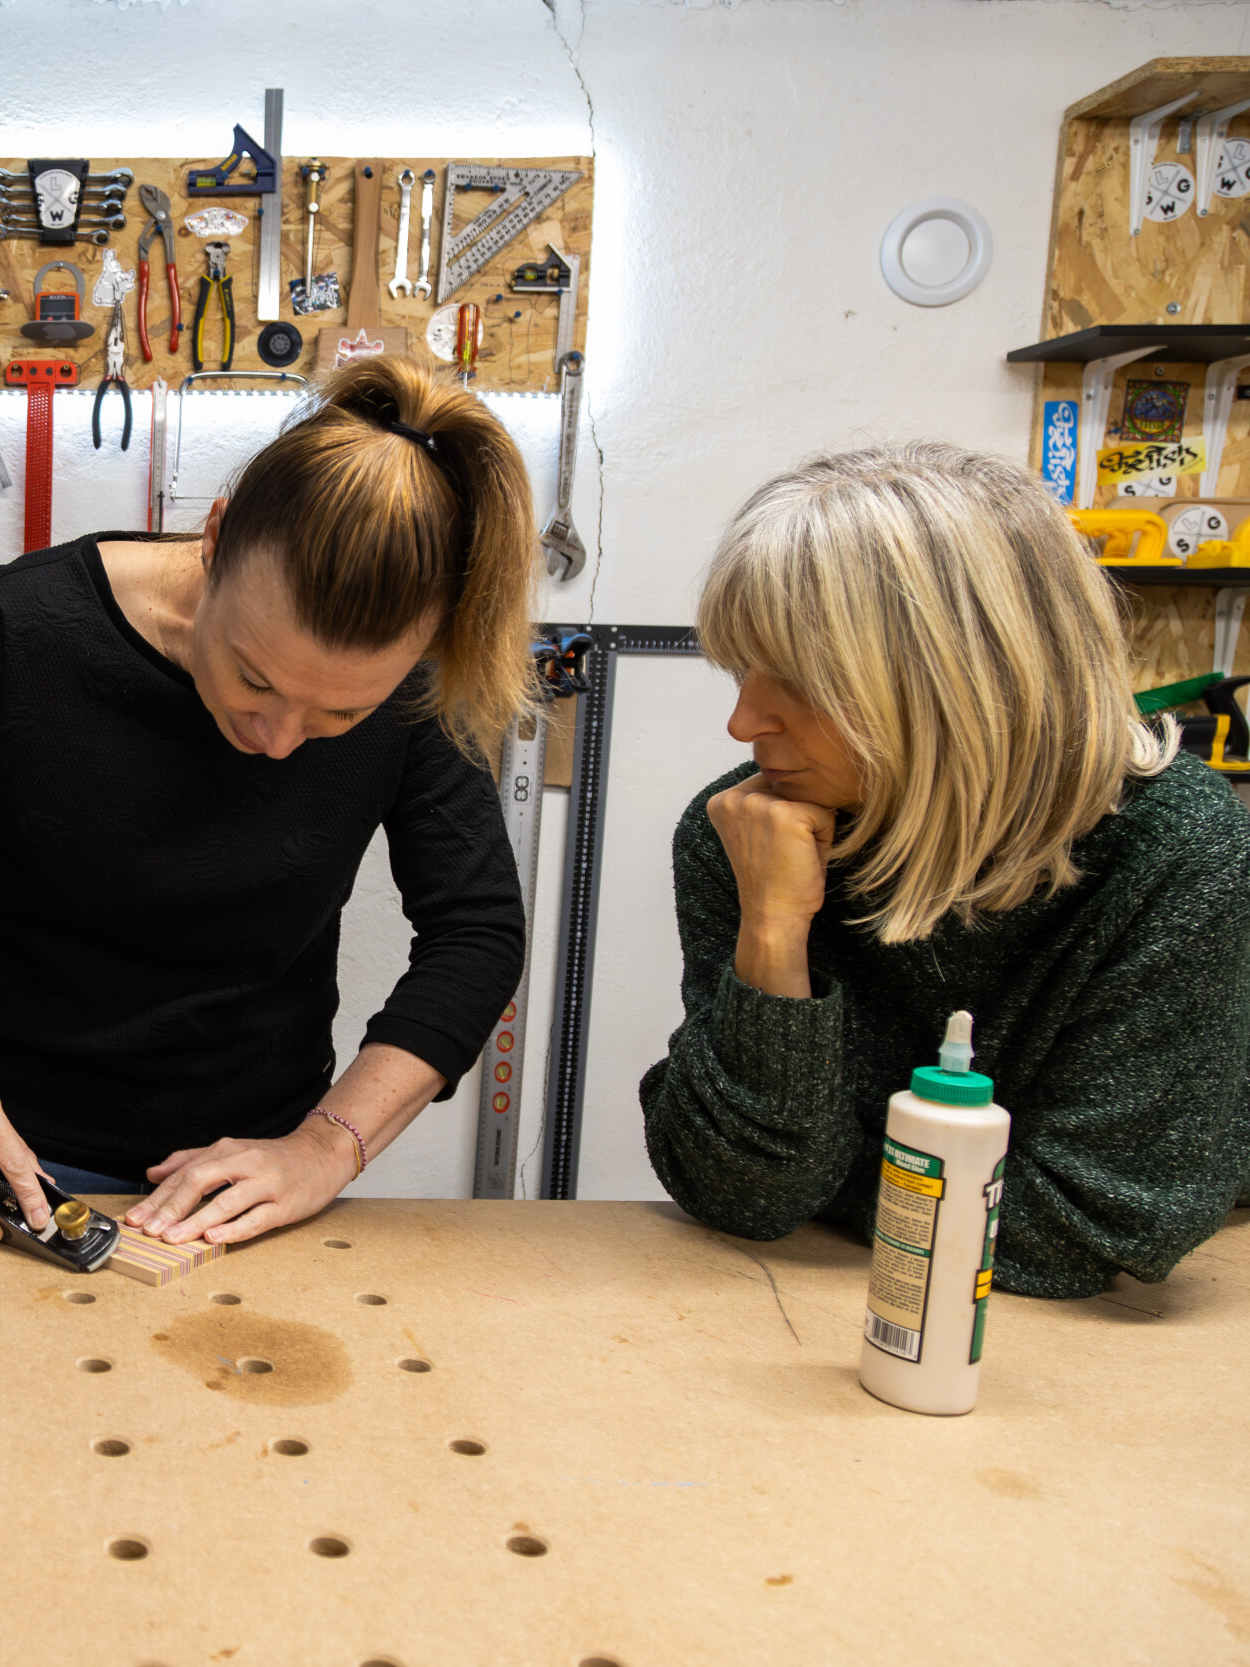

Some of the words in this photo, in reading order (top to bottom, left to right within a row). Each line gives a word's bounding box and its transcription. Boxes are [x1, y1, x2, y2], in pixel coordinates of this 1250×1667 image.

[1177, 178, 1190, 193] G
[1160, 201, 1175, 215] W
[50, 209, 64, 222] W
[1207, 516, 1221, 530] G
[1177, 538, 1190, 553] S
[894, 1149, 930, 1169] ULTIMATE
